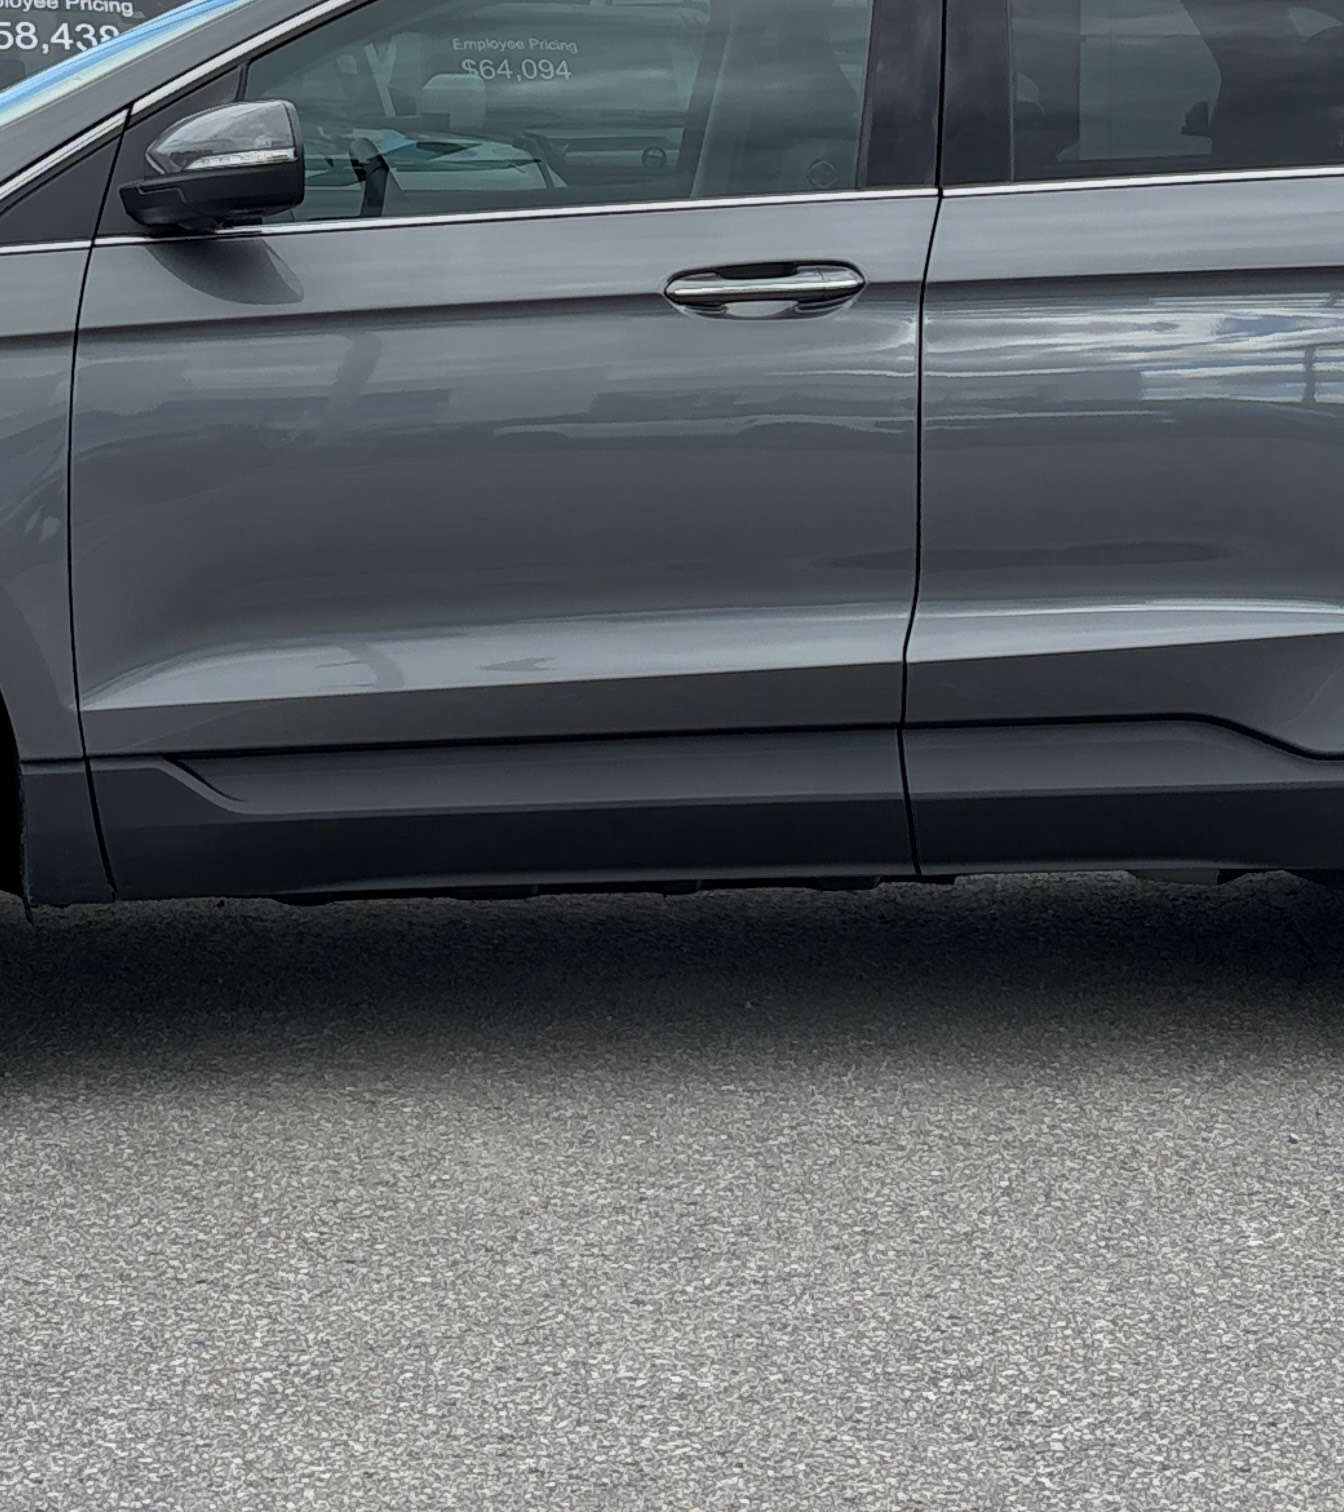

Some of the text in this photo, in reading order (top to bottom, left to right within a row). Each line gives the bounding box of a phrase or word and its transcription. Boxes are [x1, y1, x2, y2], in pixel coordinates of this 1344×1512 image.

[452, 38, 578, 54] Employee Pricing
[461, 58, 571, 81] $64,094
